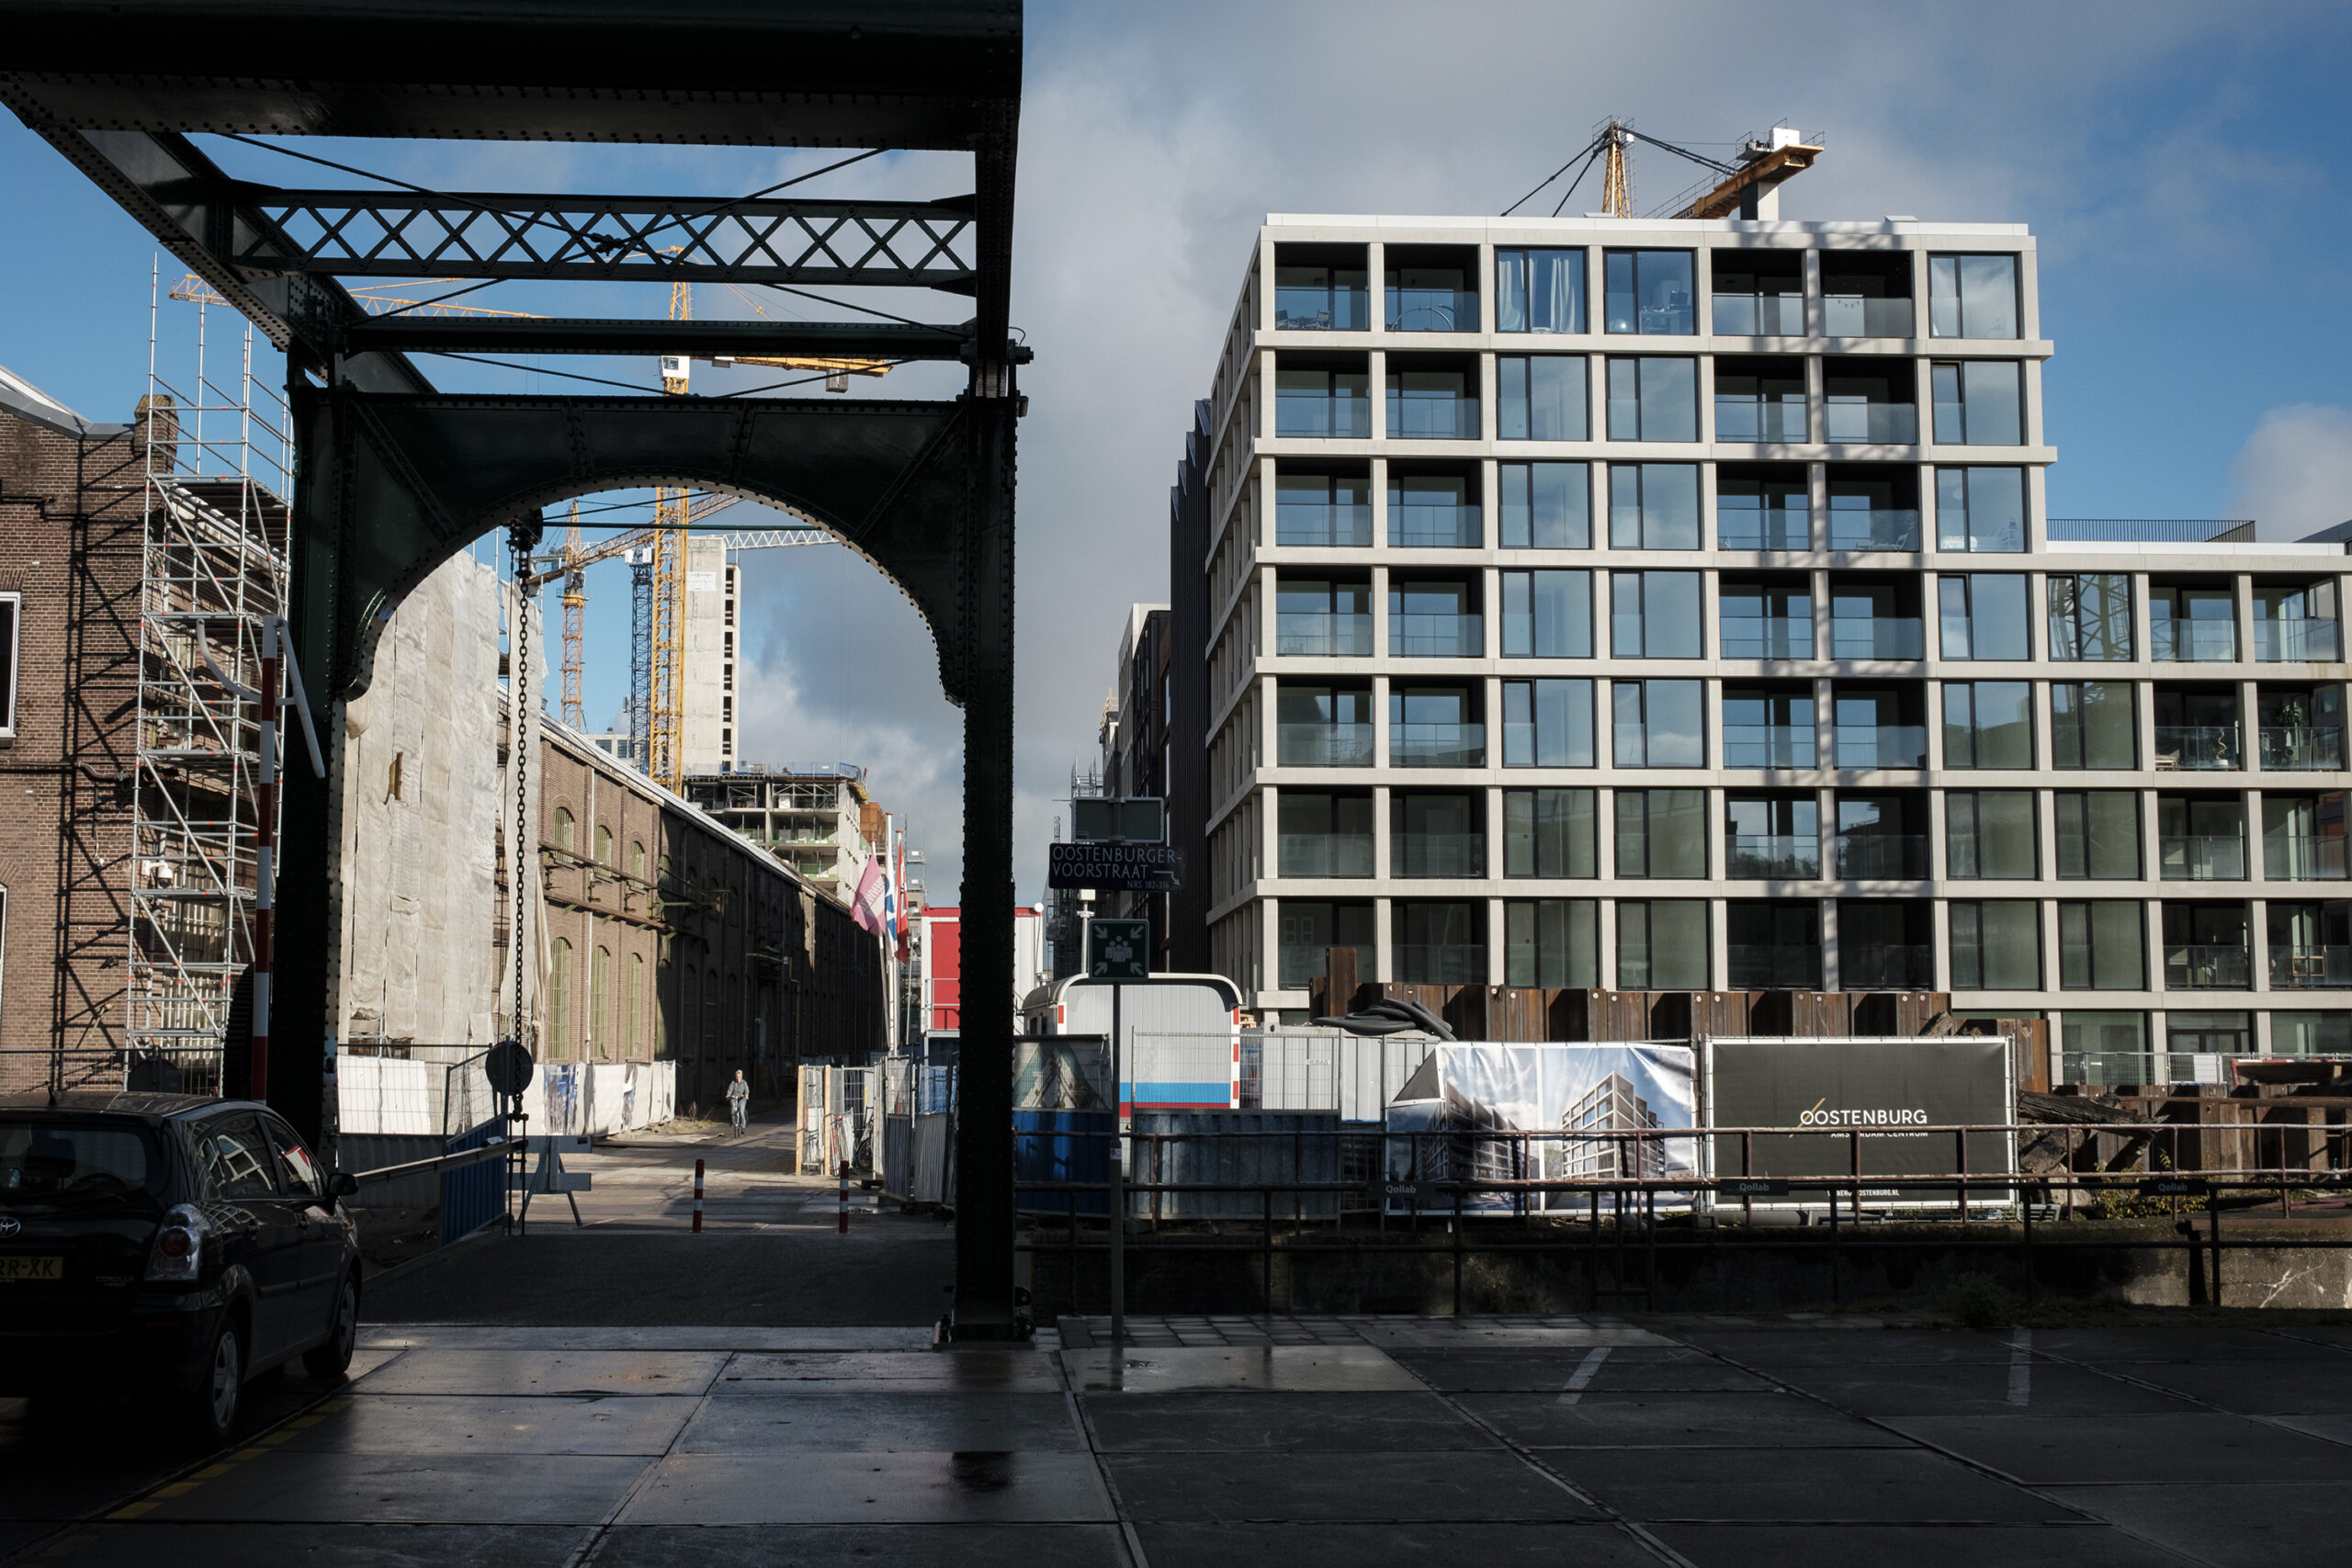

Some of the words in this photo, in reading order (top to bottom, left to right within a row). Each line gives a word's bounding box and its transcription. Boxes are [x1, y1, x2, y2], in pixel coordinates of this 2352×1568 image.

[1052, 845, 1182, 863] OOSTENBURGER-
[1051, 862, 1148, 879] VOORSTRAAT
[1126, 880, 1143, 889] NRS
[1385, 1184, 1417, 1194] Qollab
[1739, 1182, 1770, 1192] Qollab
[2158, 1182, 2188, 1192] Qollab
